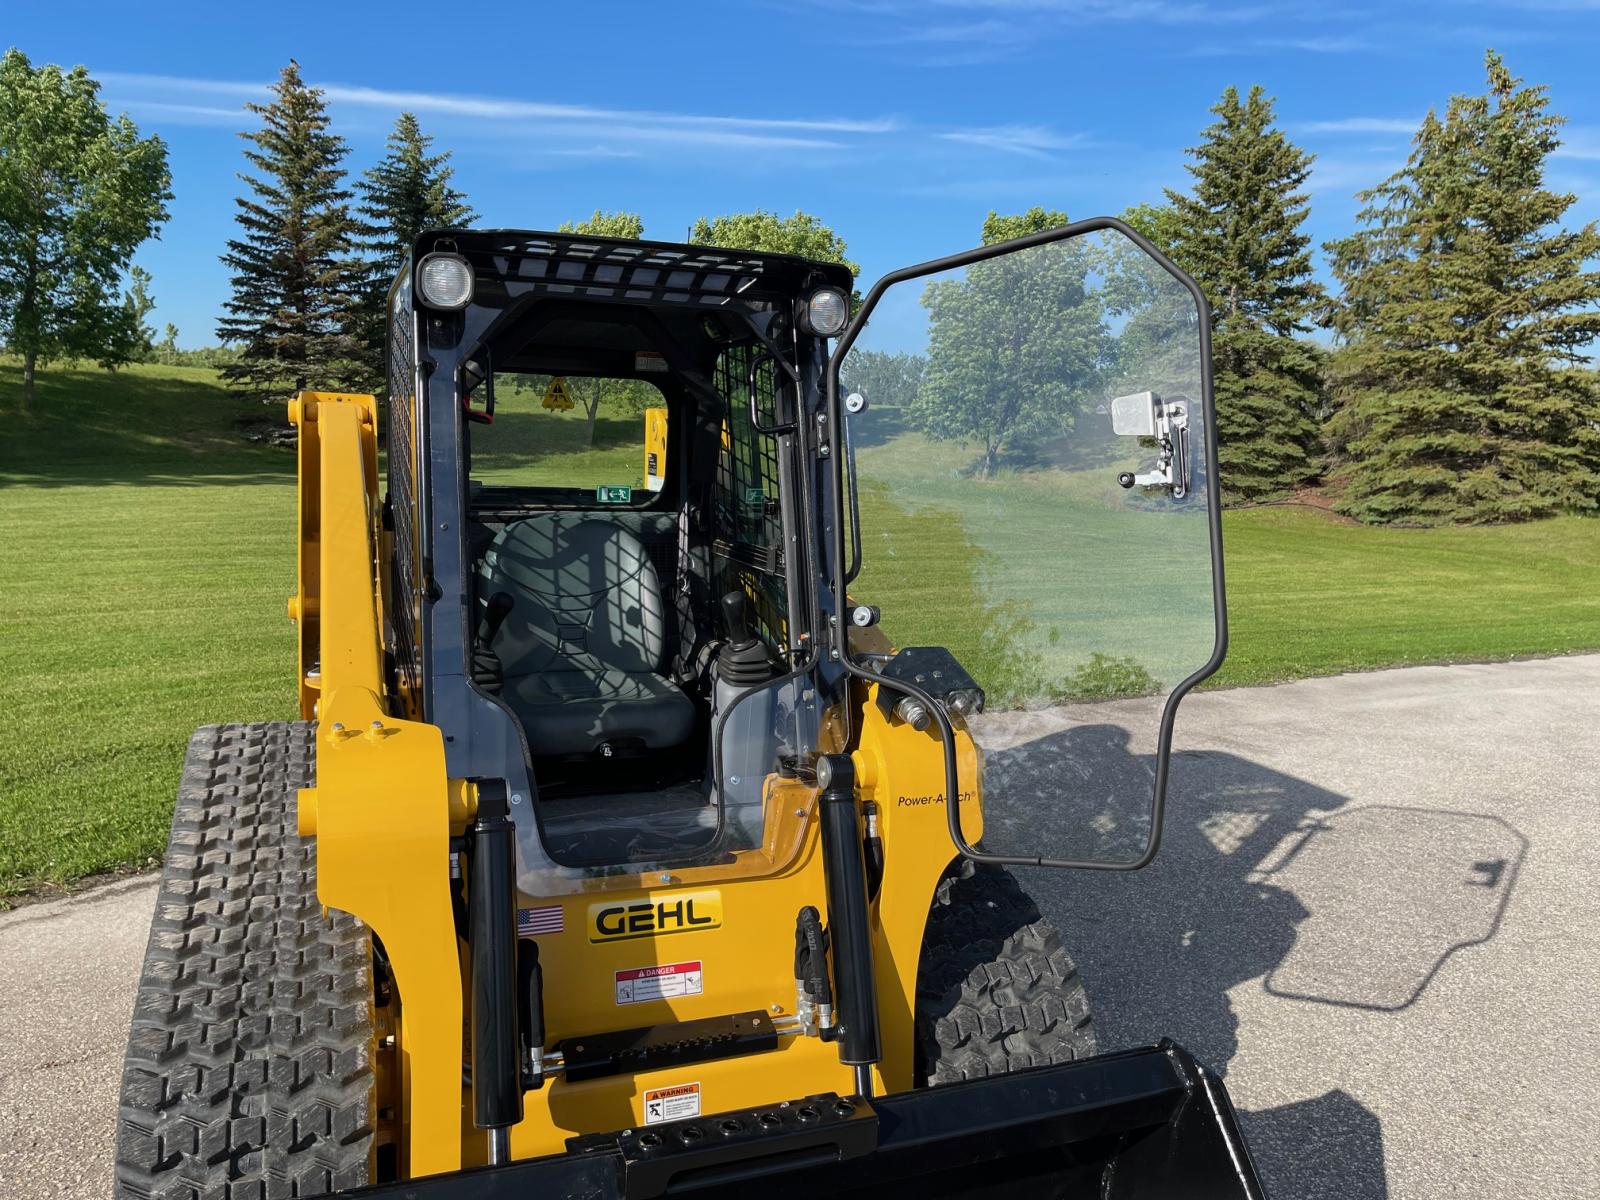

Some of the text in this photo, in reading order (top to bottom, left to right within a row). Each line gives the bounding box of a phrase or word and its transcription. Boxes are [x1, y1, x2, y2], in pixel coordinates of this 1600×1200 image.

[596, 899, 712, 935] GEHL
[646, 966, 675, 977] DANGER
[660, 1086, 694, 1097] WARNING
